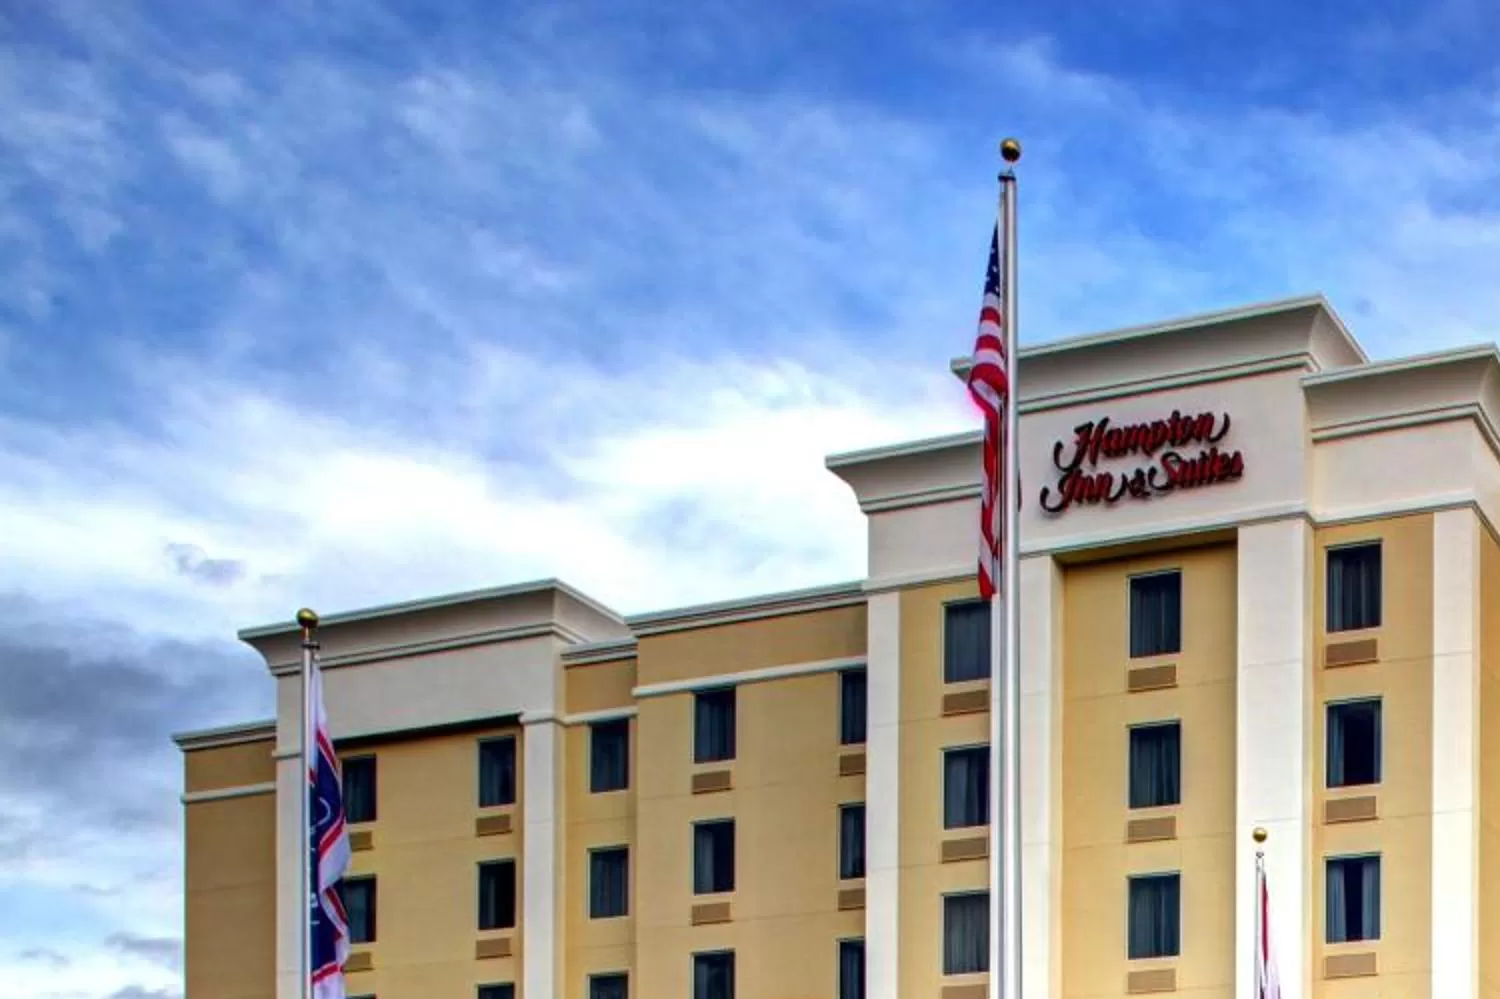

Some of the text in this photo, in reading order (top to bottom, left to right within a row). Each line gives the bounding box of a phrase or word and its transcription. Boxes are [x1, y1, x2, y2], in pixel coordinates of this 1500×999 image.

[1054, 410, 1230, 472] Hampton
[1040, 467, 1126, 512] Inn
[1149, 447, 1245, 491] Suites
